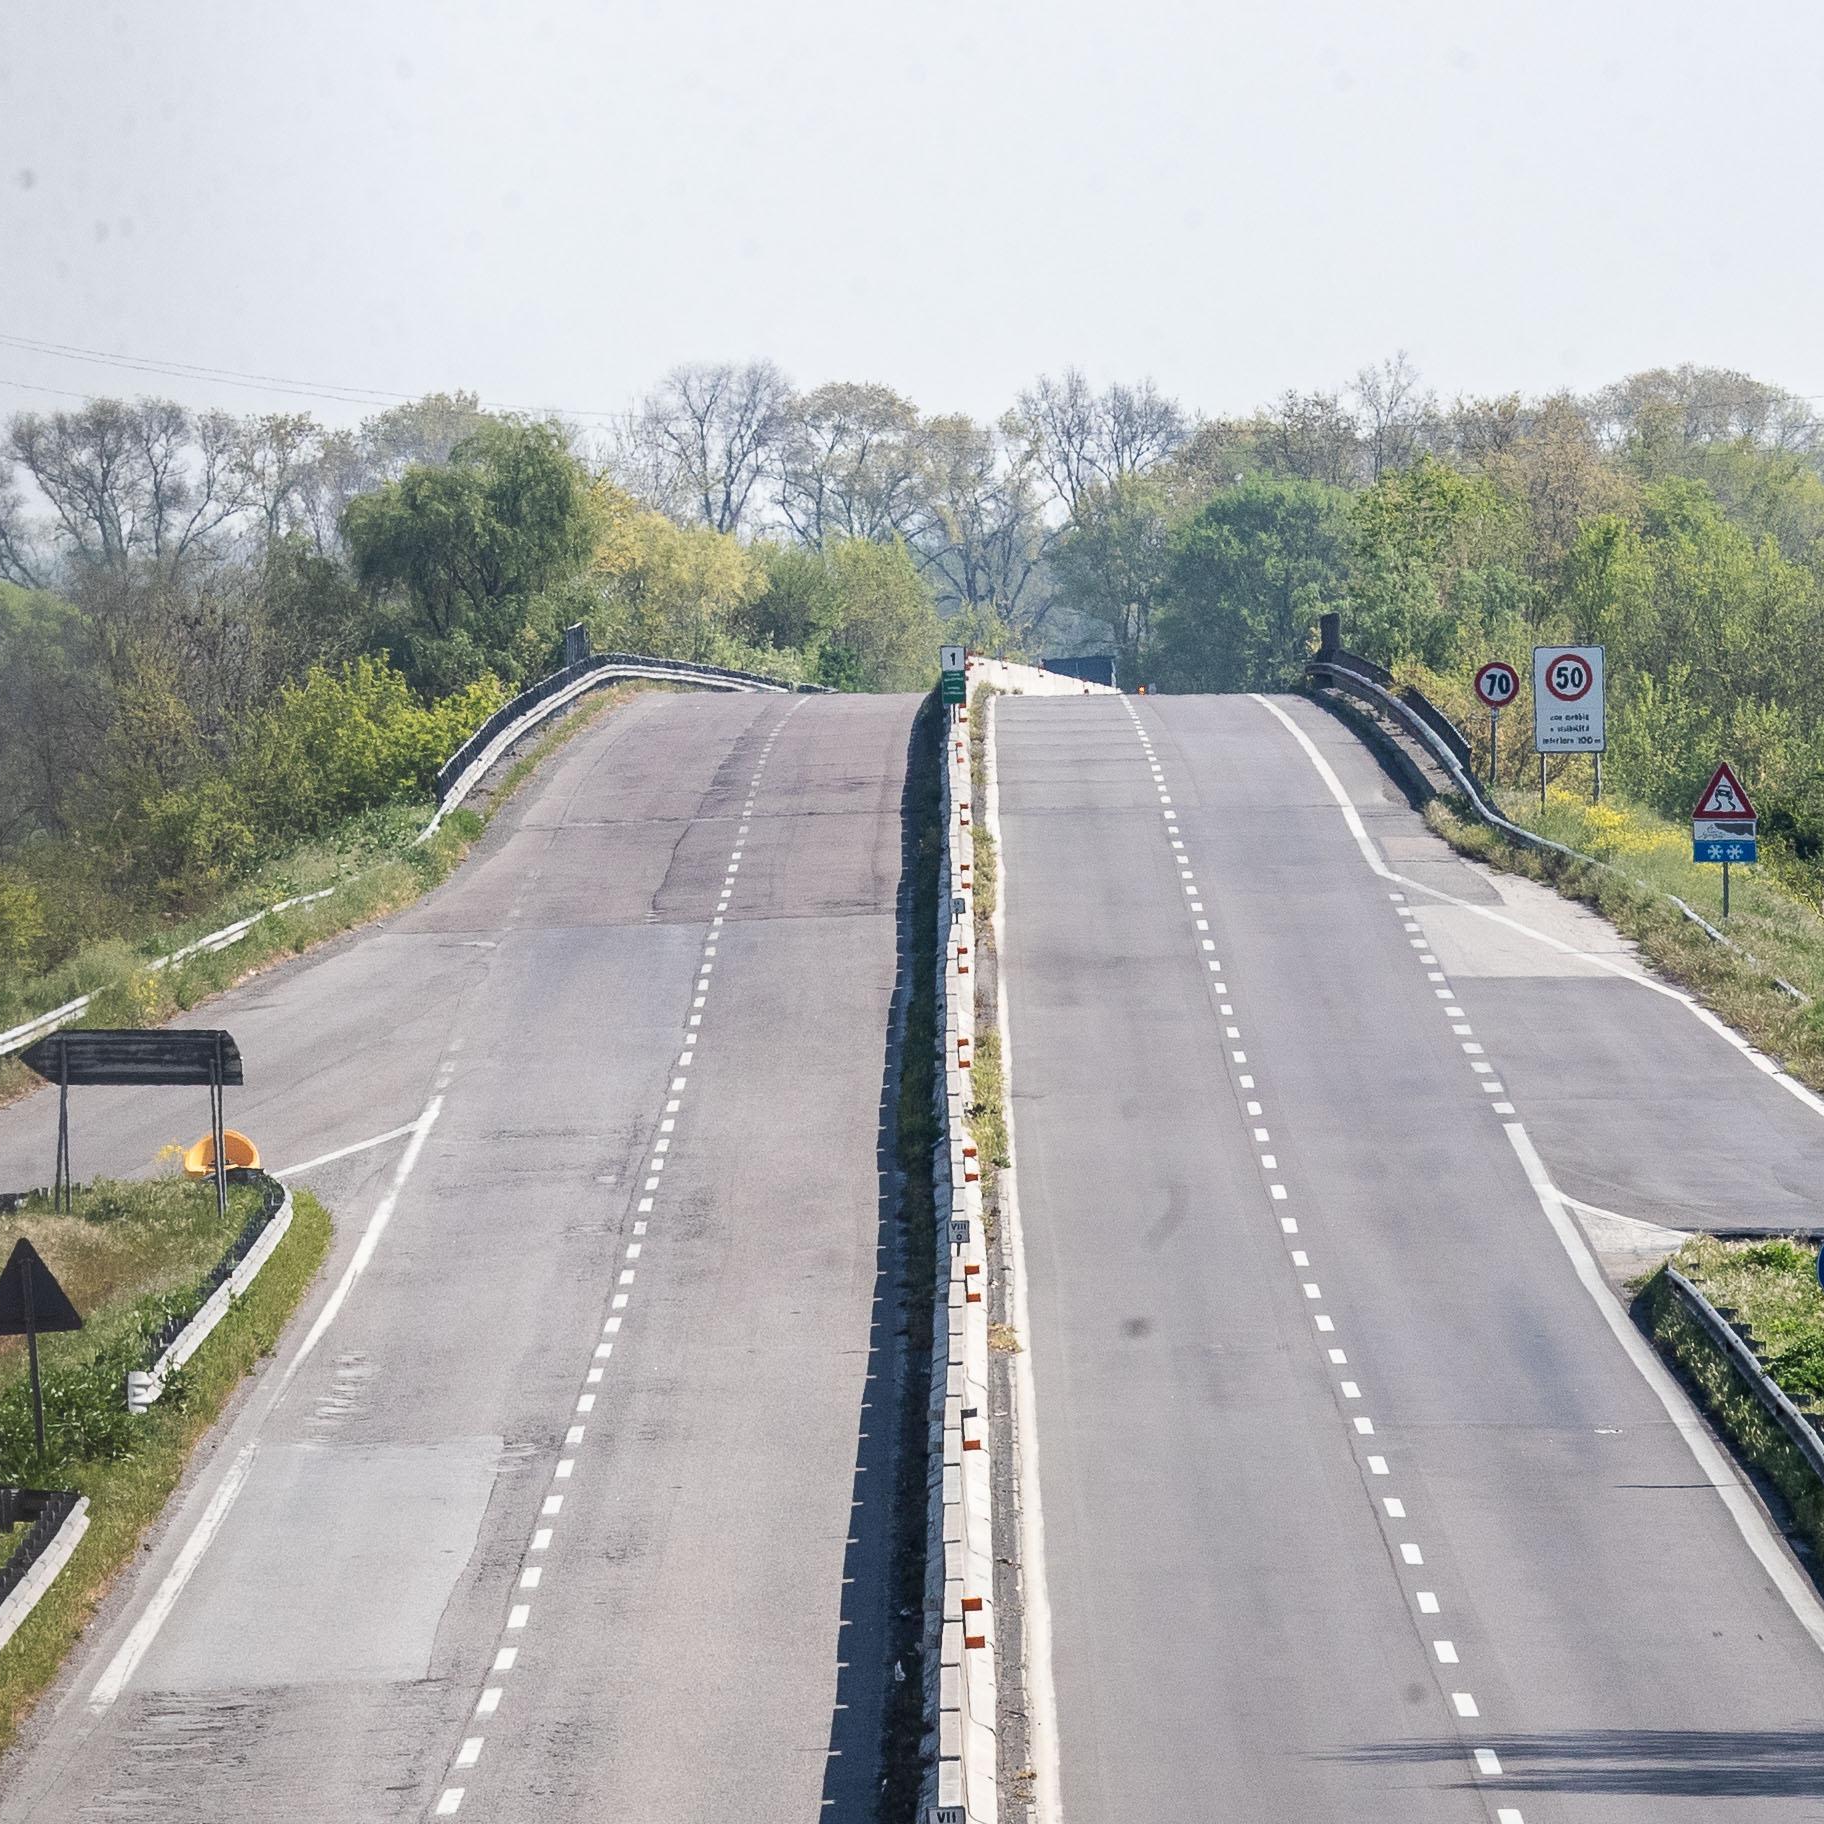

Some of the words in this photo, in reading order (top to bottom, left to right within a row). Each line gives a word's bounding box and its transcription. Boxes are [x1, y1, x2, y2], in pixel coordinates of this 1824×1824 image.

[949, 652, 956, 666] 1
[1485, 673, 1511, 697] 70
[1556, 666, 1584, 690] 50
[936, 1811, 957, 1824] VII
